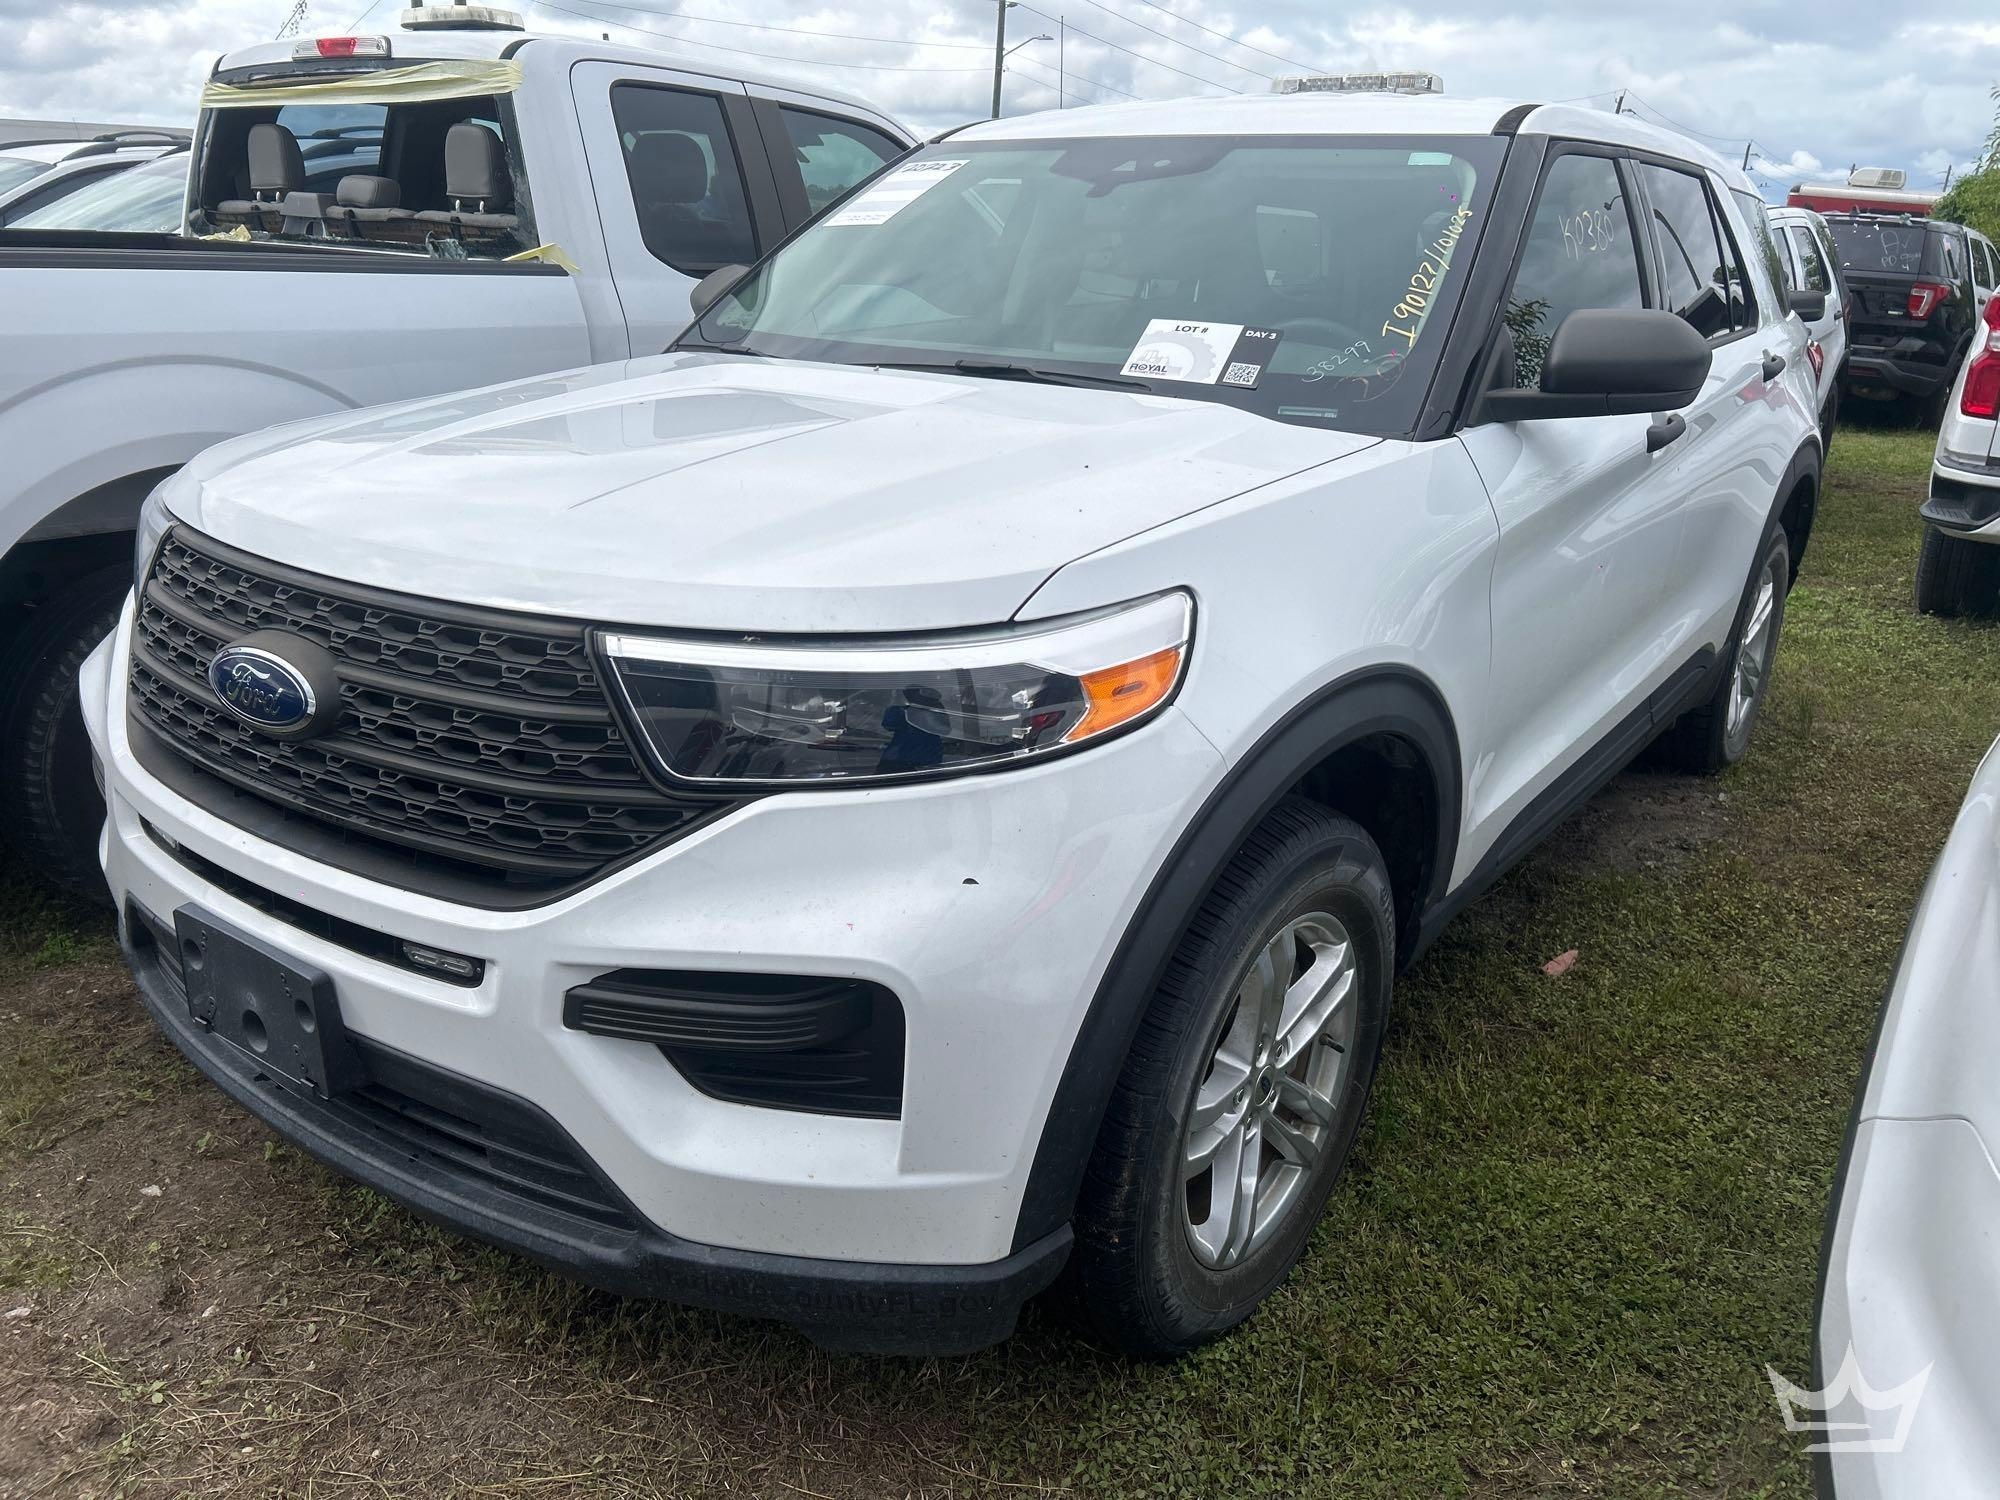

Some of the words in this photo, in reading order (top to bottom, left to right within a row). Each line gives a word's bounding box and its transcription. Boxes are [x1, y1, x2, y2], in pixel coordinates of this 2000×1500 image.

[1174, 325, 1200, 333] LOT
[1245, 330, 1268, 339] DAY
[1268, 332, 1278, 340] 3
[1129, 363, 1168, 373] ROYAL
[225, 662, 284, 716] Ford
